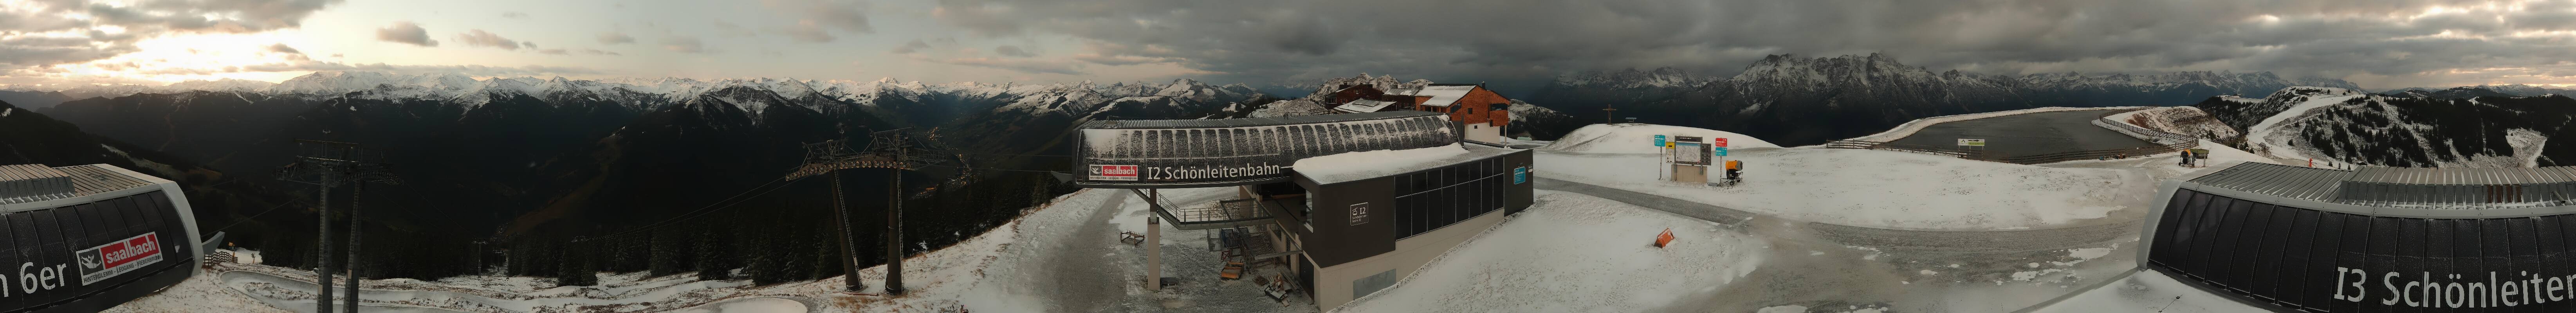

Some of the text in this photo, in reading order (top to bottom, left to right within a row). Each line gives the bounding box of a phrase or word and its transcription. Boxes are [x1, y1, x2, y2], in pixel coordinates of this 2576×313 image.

[1104, 165, 1135, 174] saalbach
[1147, 162, 1279, 180] I2 Schönleitenbahn
[106, 235, 156, 264] saalbach
[20, 262, 67, 293] 6er
[83, 270, 113, 283] HINTERGLEMM
[117, 263, 134, 273] LEOGANG
[137, 255, 161, 267] FIEBERBRUNN
[2334, 266, 2367, 302] I3
